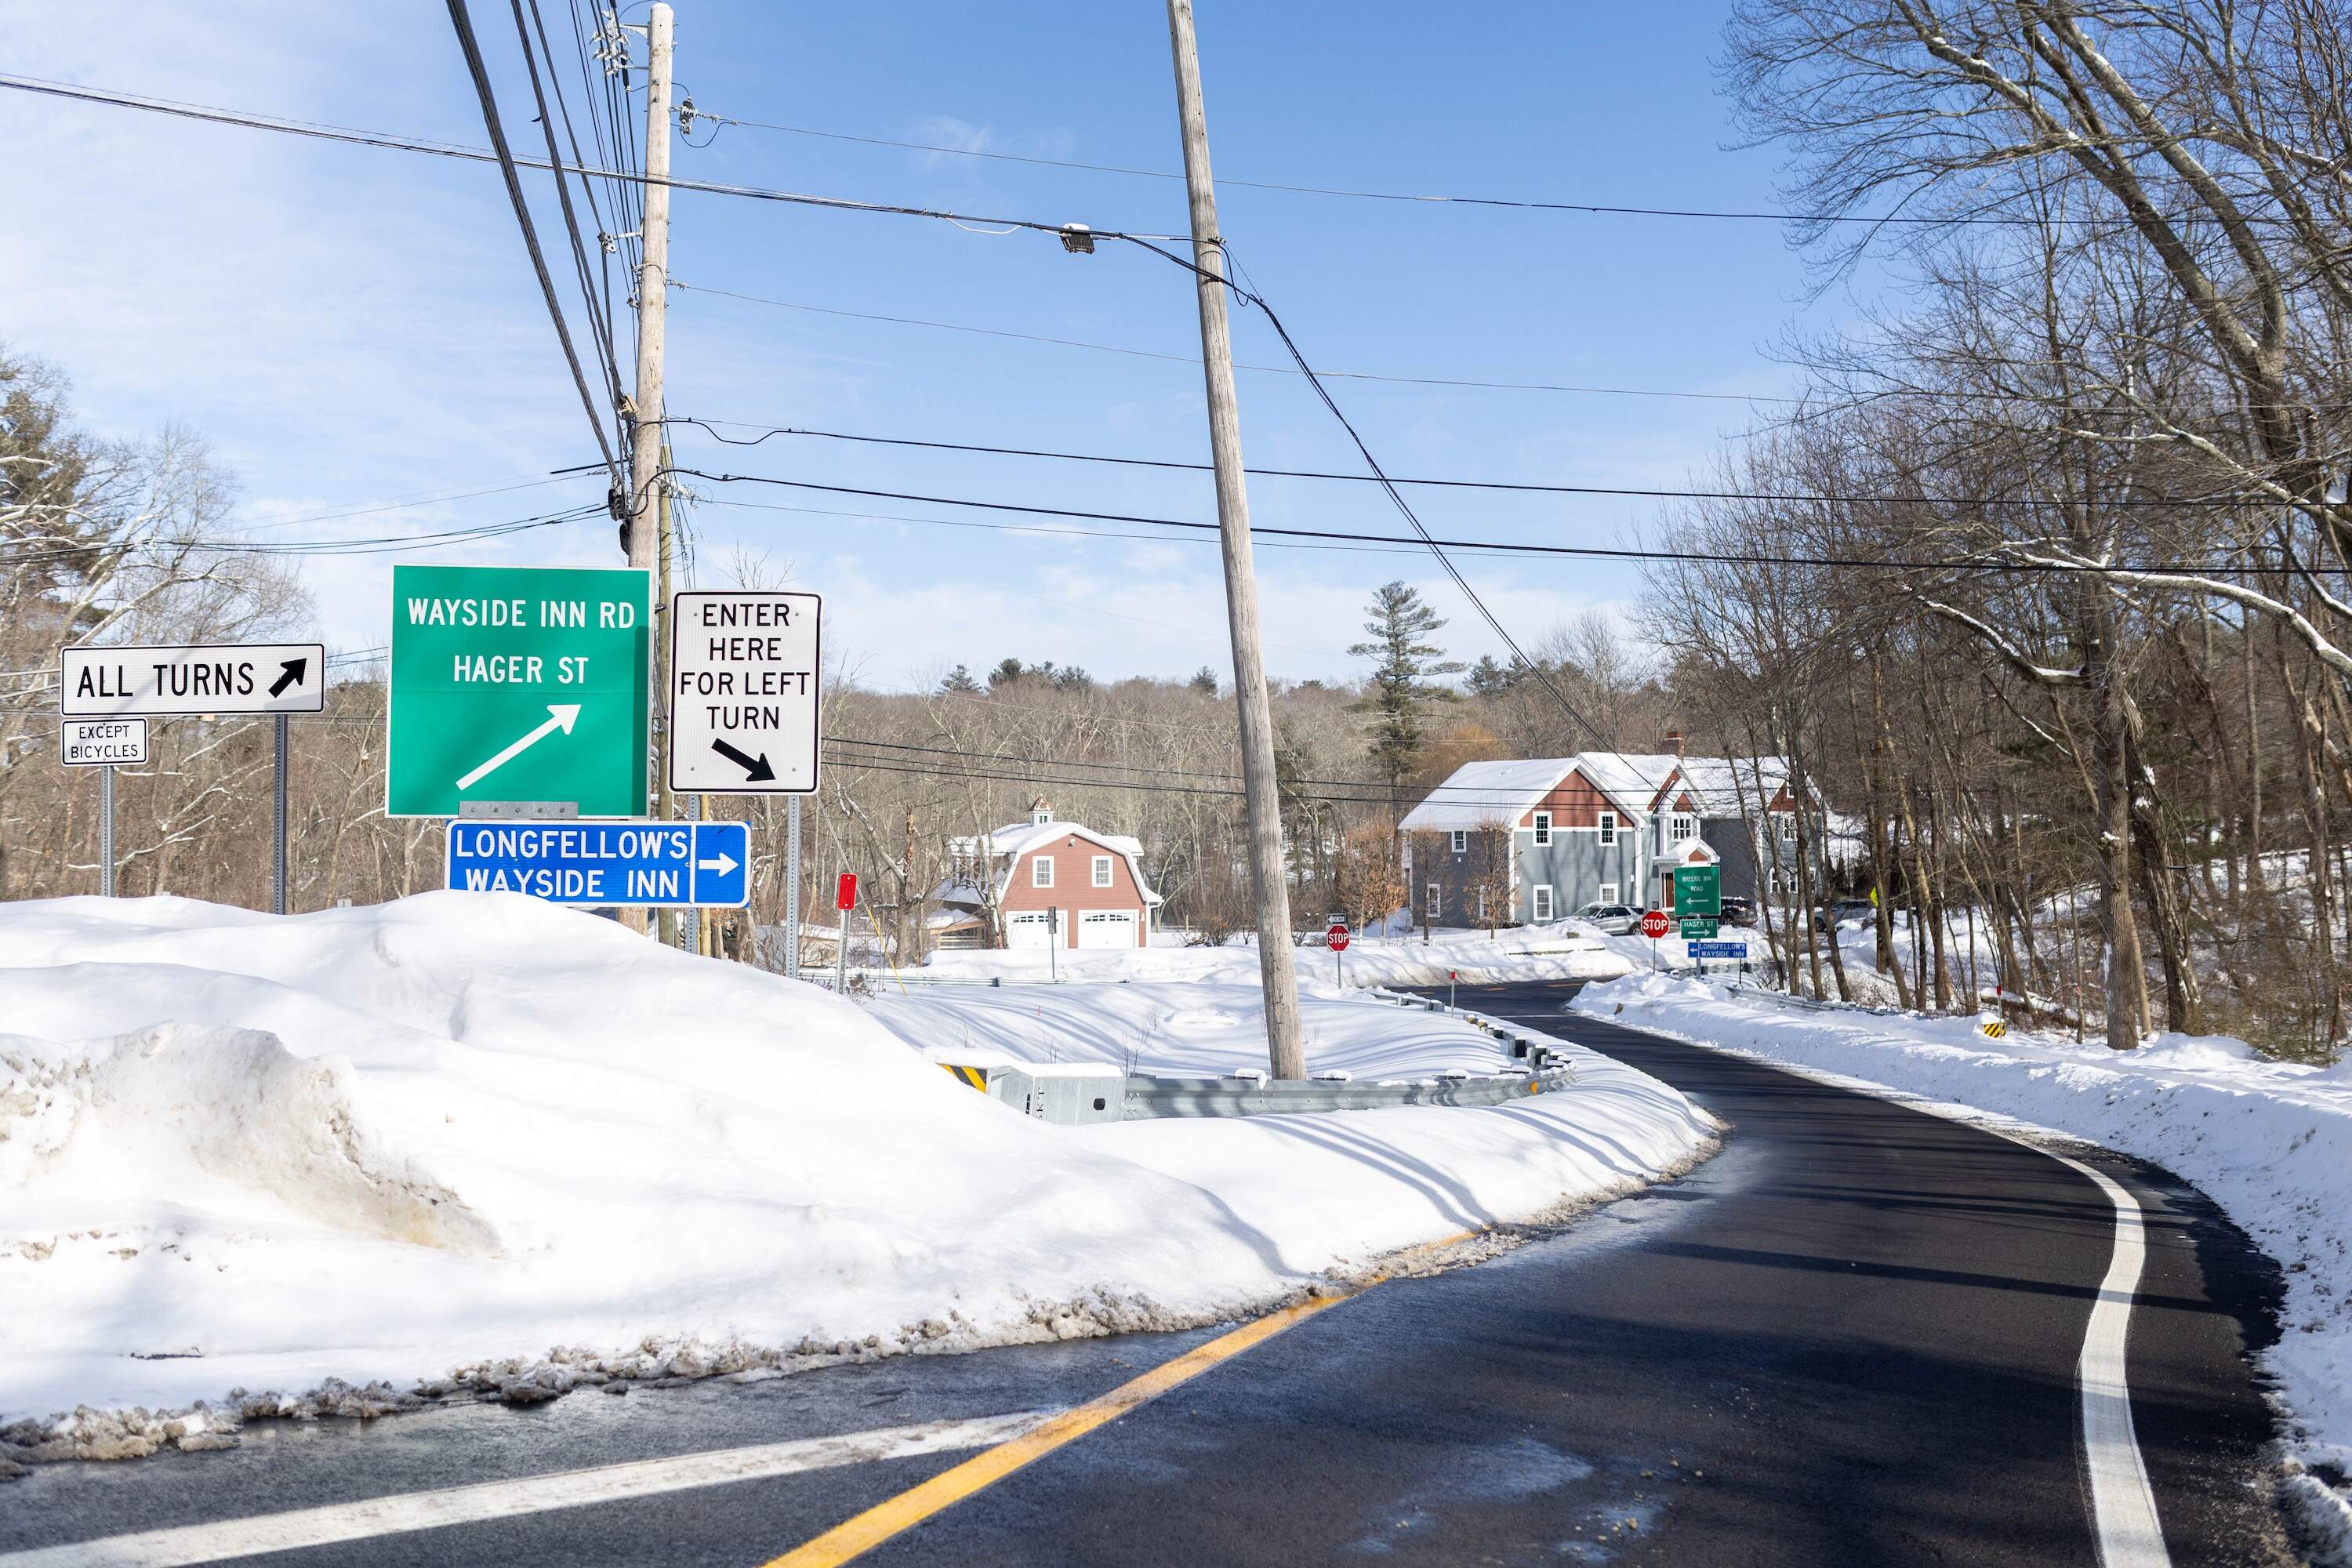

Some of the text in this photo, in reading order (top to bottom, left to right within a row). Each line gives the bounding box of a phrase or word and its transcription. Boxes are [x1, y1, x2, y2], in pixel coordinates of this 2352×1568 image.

[407, 597, 635, 628] WAYSIDE INN RD
[702, 604, 790, 626] ENTER
[710, 637, 782, 661] HERE
[77, 662, 255, 698] ALL TURNS
[453, 655, 589, 684] HAGER ST
[681, 672, 810, 695] FOR LEFT
[706, 706, 779, 729] TURN
[78, 725, 130, 739] EXCEPT
[71, 745, 139, 759] BICYCLES
[456, 829, 688, 859] LONGFELLOW'S
[466, 868, 678, 898] WAYSIDE INN
[1642, 919, 1668, 931] STOP
[1328, 933, 1348, 944] STOP
